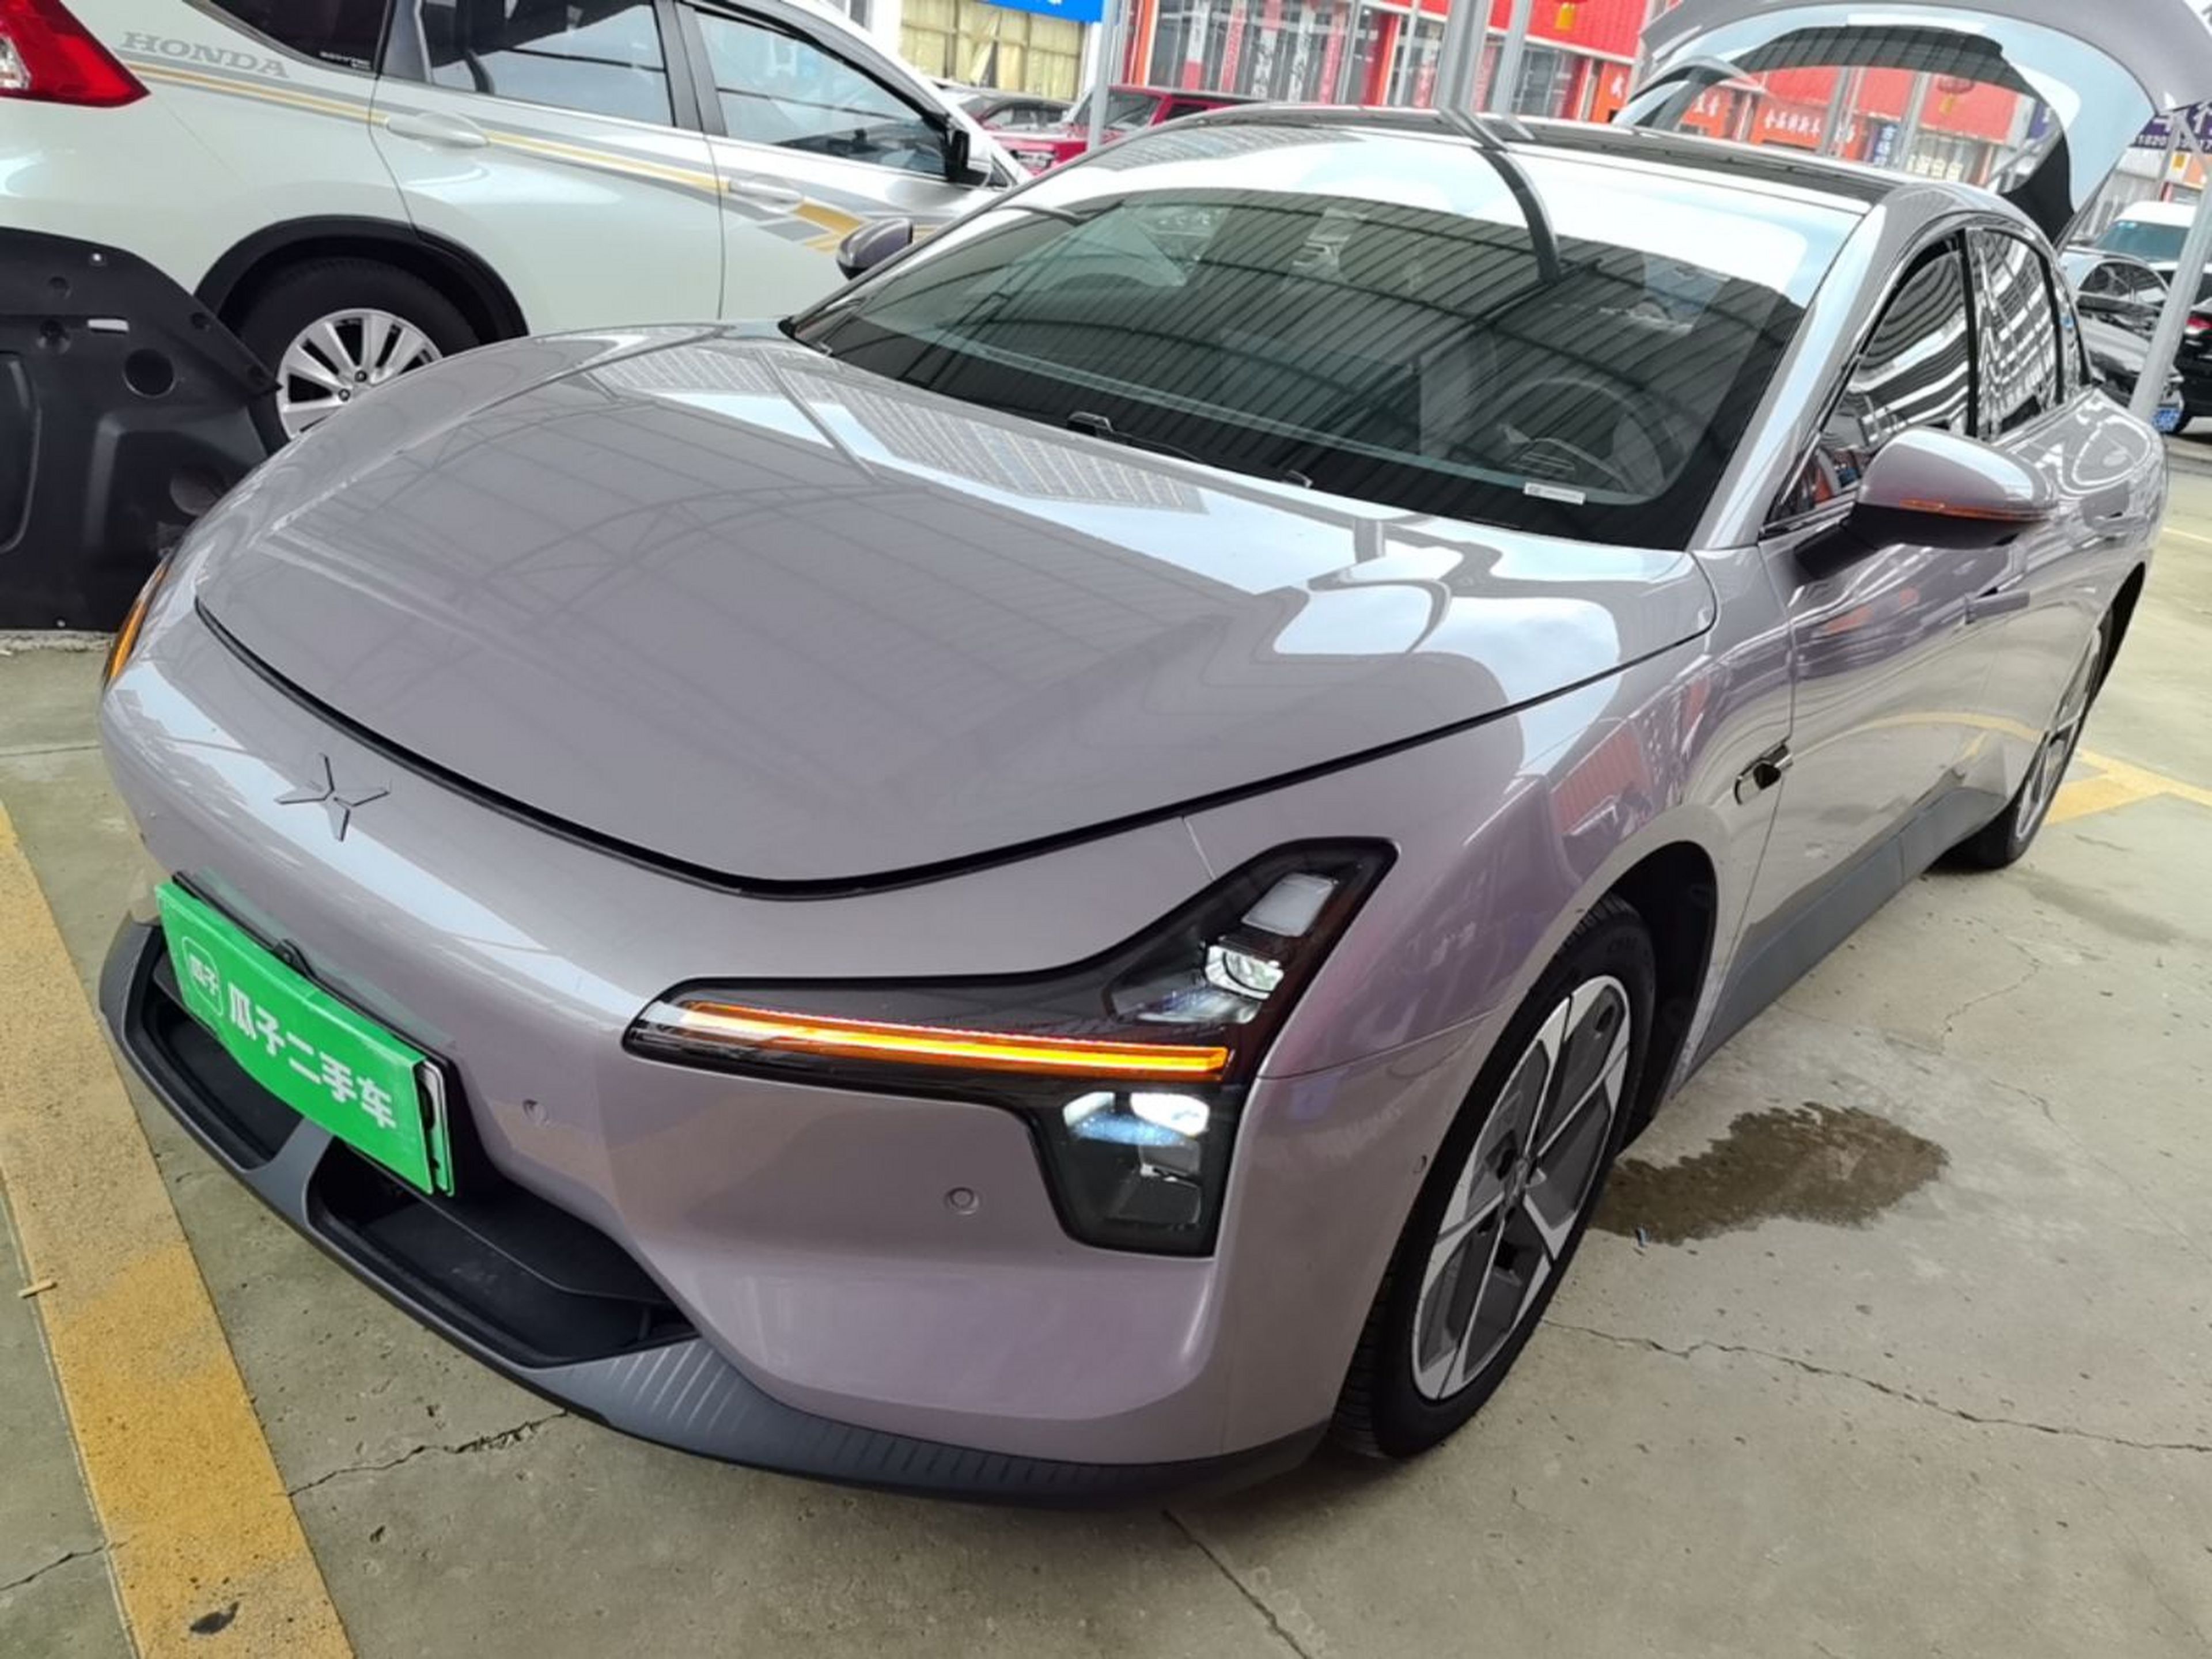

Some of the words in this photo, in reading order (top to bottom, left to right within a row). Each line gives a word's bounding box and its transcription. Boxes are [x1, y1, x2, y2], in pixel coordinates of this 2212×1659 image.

[122, 31, 289, 78] HONDA
[228, 982, 396, 1129] 瓜子二手车
